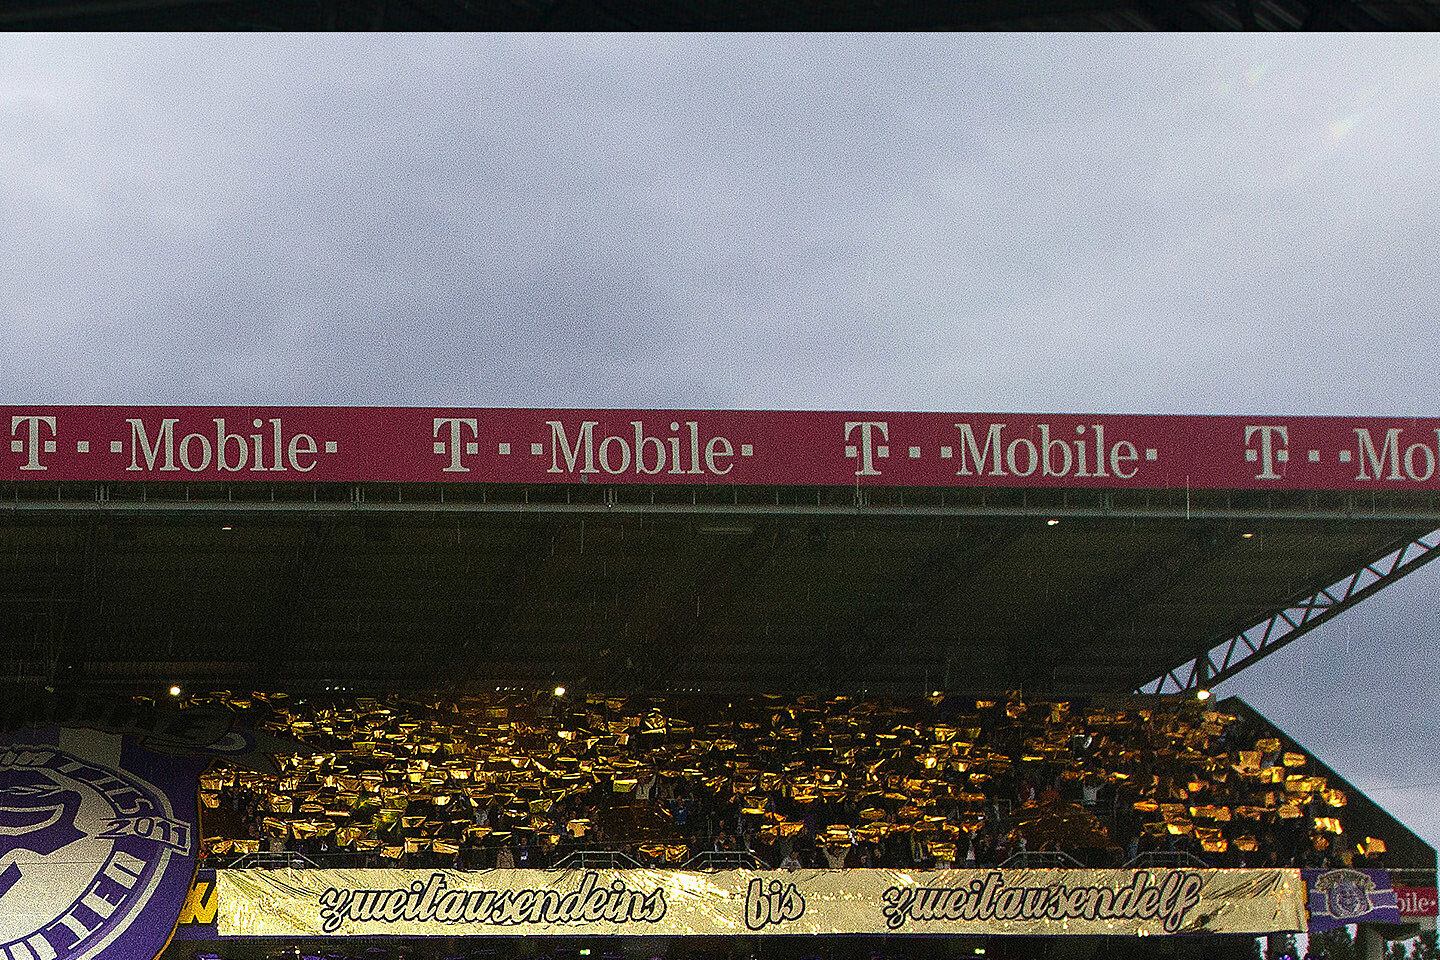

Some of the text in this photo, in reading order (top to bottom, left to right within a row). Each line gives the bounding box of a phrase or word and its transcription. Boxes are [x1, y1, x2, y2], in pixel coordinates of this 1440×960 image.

[126, 419, 317, 471] Mobile
[546, 421, 733, 475] Mobile
[955, 424, 1138, 478] Mobile
[104, 817, 189, 850] 2011
[319, 871, 1205, 934] zweitausendeins bis zweitausendelf
